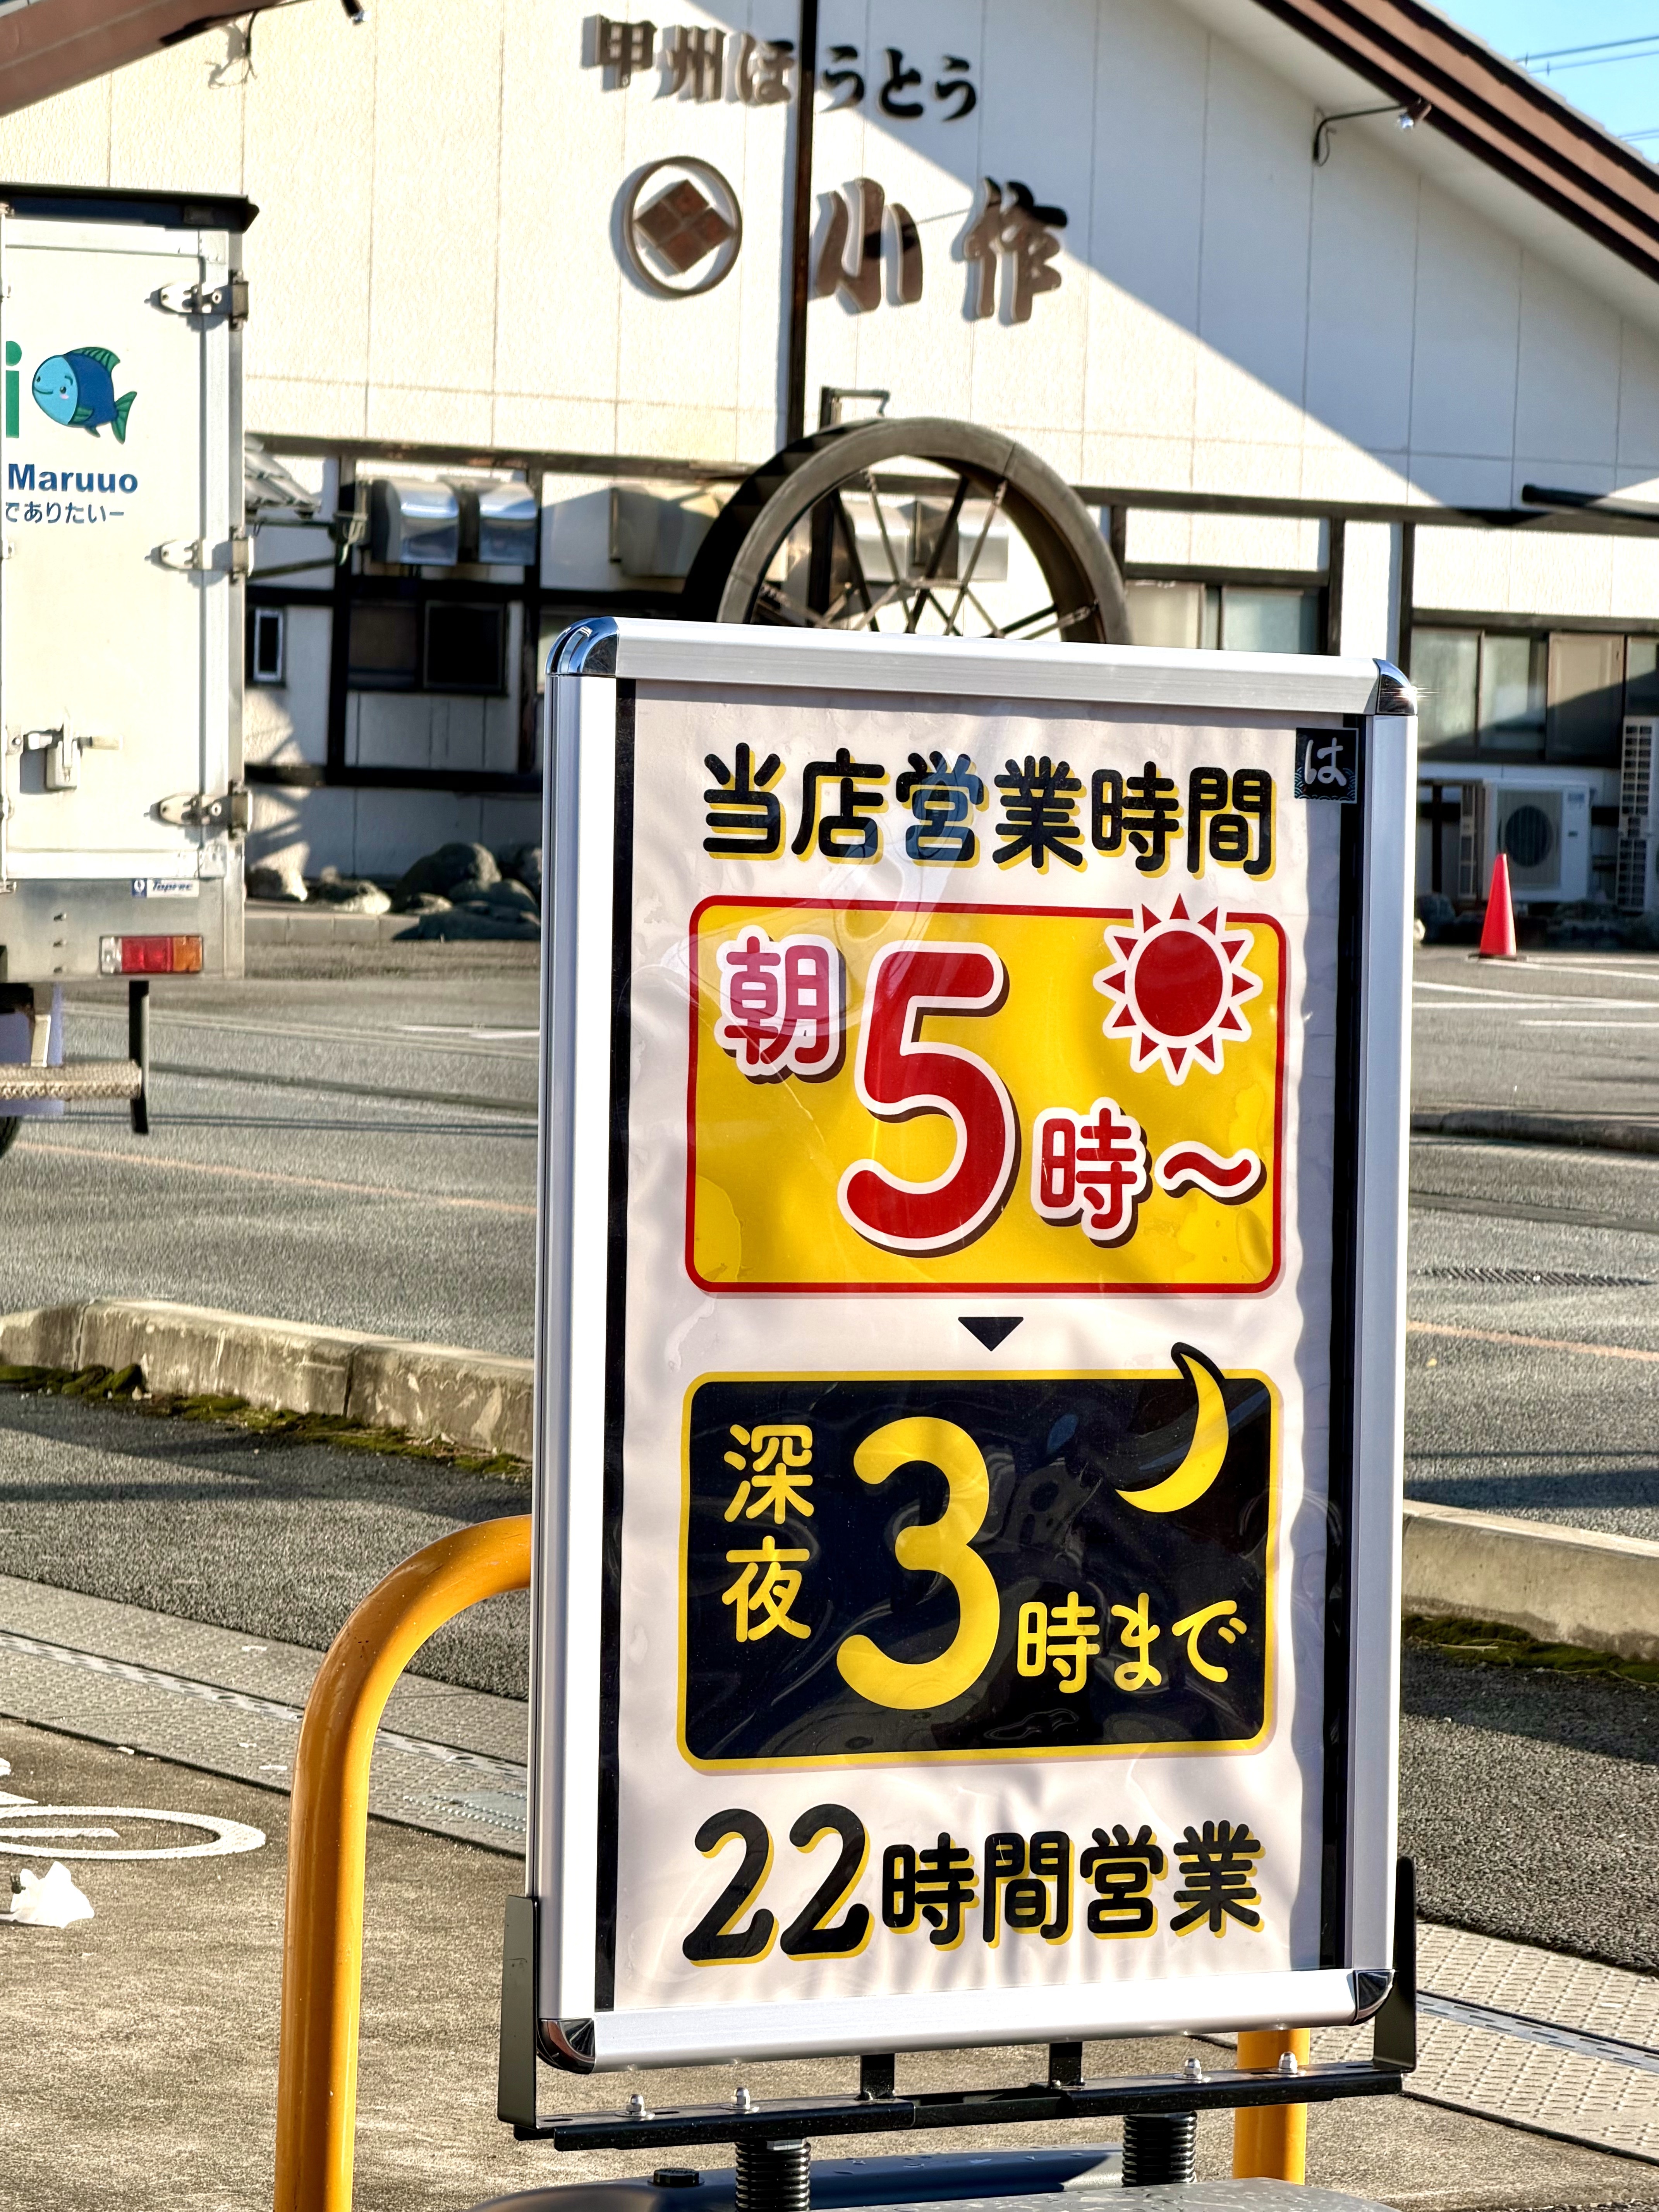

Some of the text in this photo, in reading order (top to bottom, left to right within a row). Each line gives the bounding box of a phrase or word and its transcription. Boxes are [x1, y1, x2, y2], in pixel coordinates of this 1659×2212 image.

[592, 15, 977, 122] 甲州ほうとう
[812, 176, 1068, 325] 小作
[8, 463, 138, 493] Maruuo
[703, 742, 1277, 882] 当店営業時間
[1304, 737, 1347, 786] は
[720, 936, 830, 1065] 朝
[682, 1803, 1266, 1966] 22時間営業
